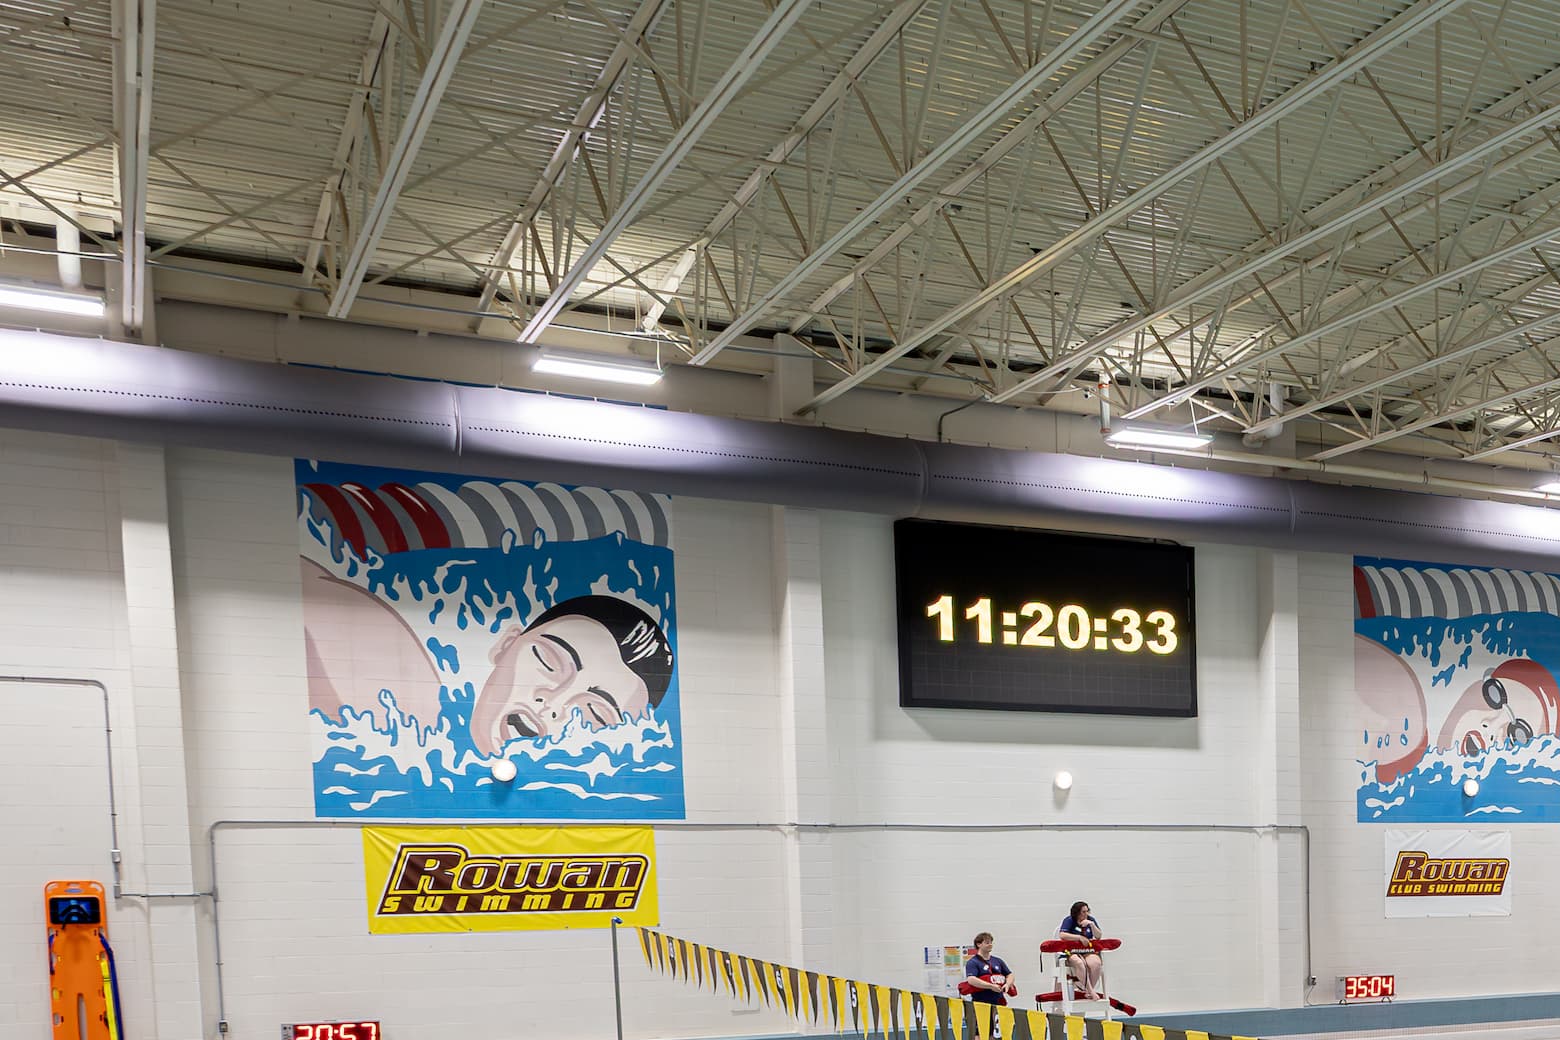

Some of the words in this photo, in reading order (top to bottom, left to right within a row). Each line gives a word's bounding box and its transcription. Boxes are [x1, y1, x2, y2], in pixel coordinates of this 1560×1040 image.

[926, 594, 1178, 655] 11:20:33
[1390, 884, 1422, 894] CLUB
[1427, 883, 1503, 893] SWIMMING
[1346, 977, 1393, 998] 35:04
